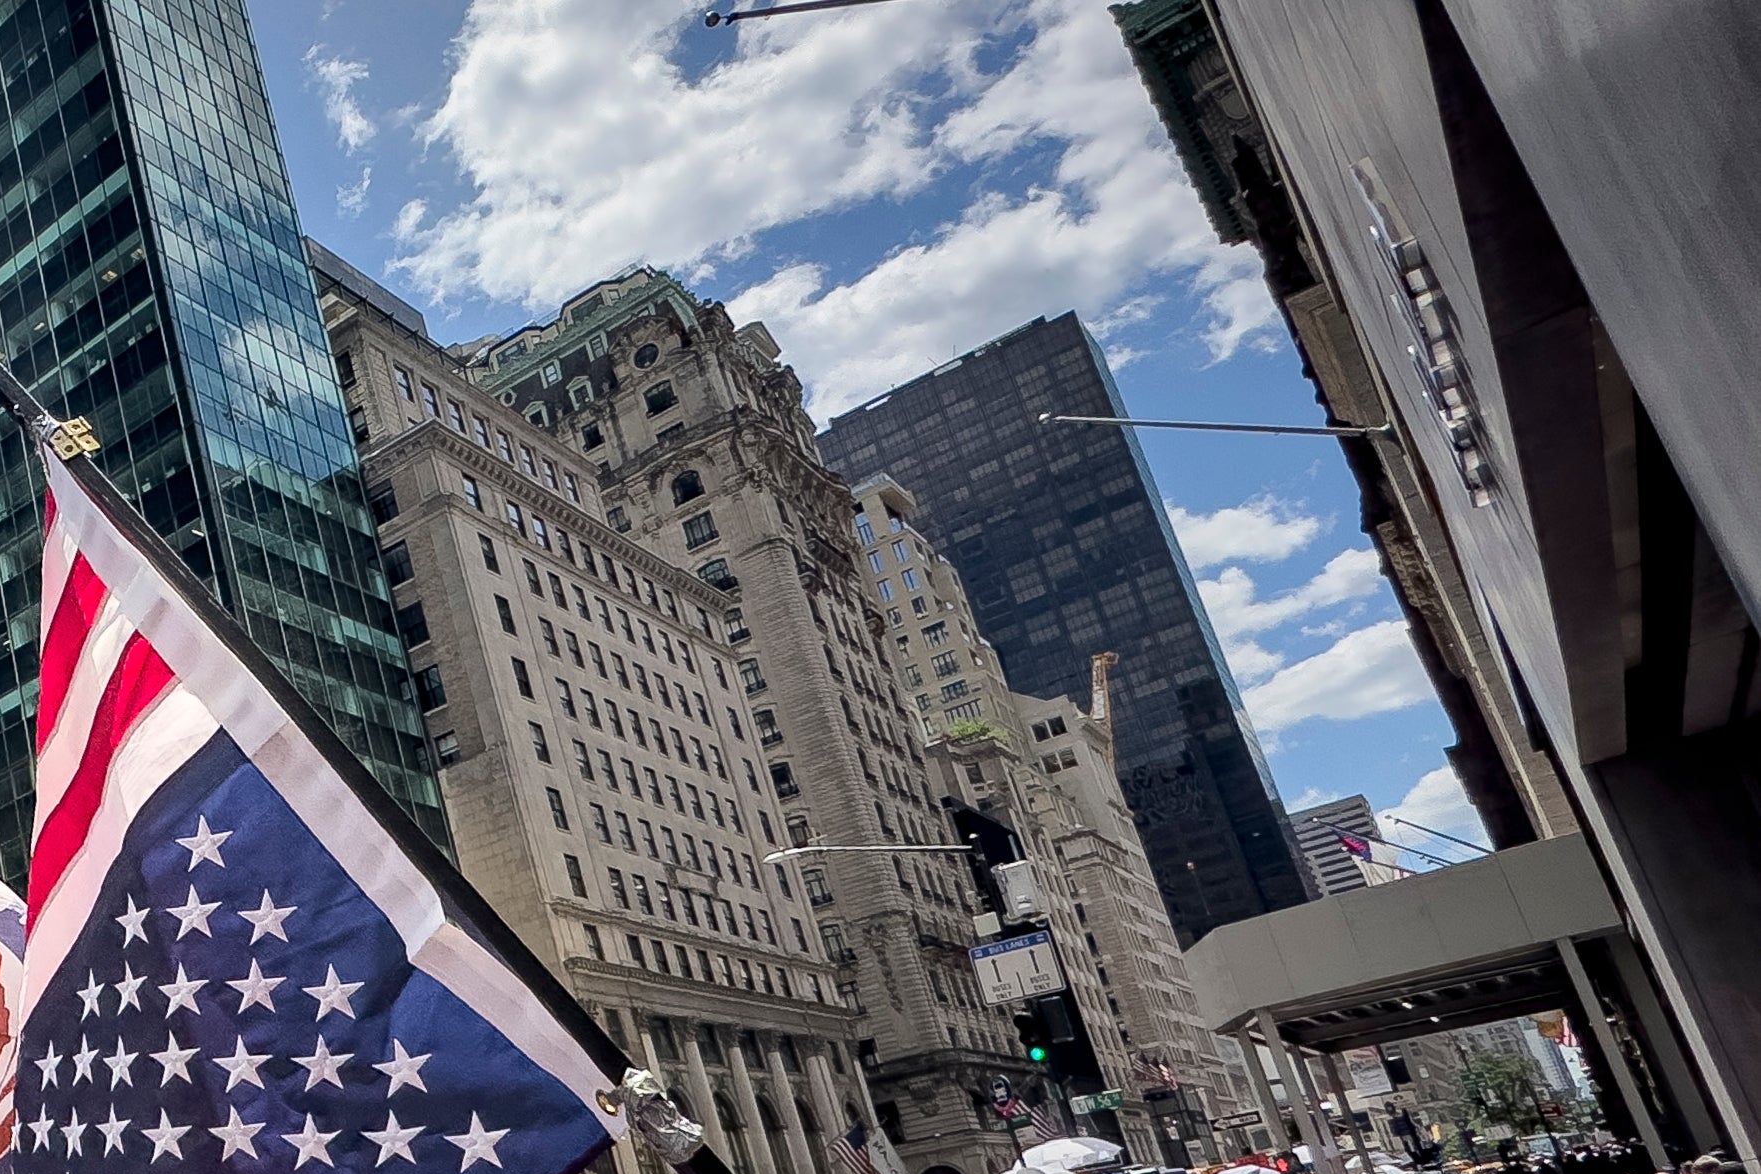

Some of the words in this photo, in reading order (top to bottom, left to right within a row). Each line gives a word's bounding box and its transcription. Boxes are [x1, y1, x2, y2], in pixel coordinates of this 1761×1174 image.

[988, 945, 1004, 955] BUS
[1005, 938, 1030, 950] LANES
[1098, 1095, 1112, 1107] 56
